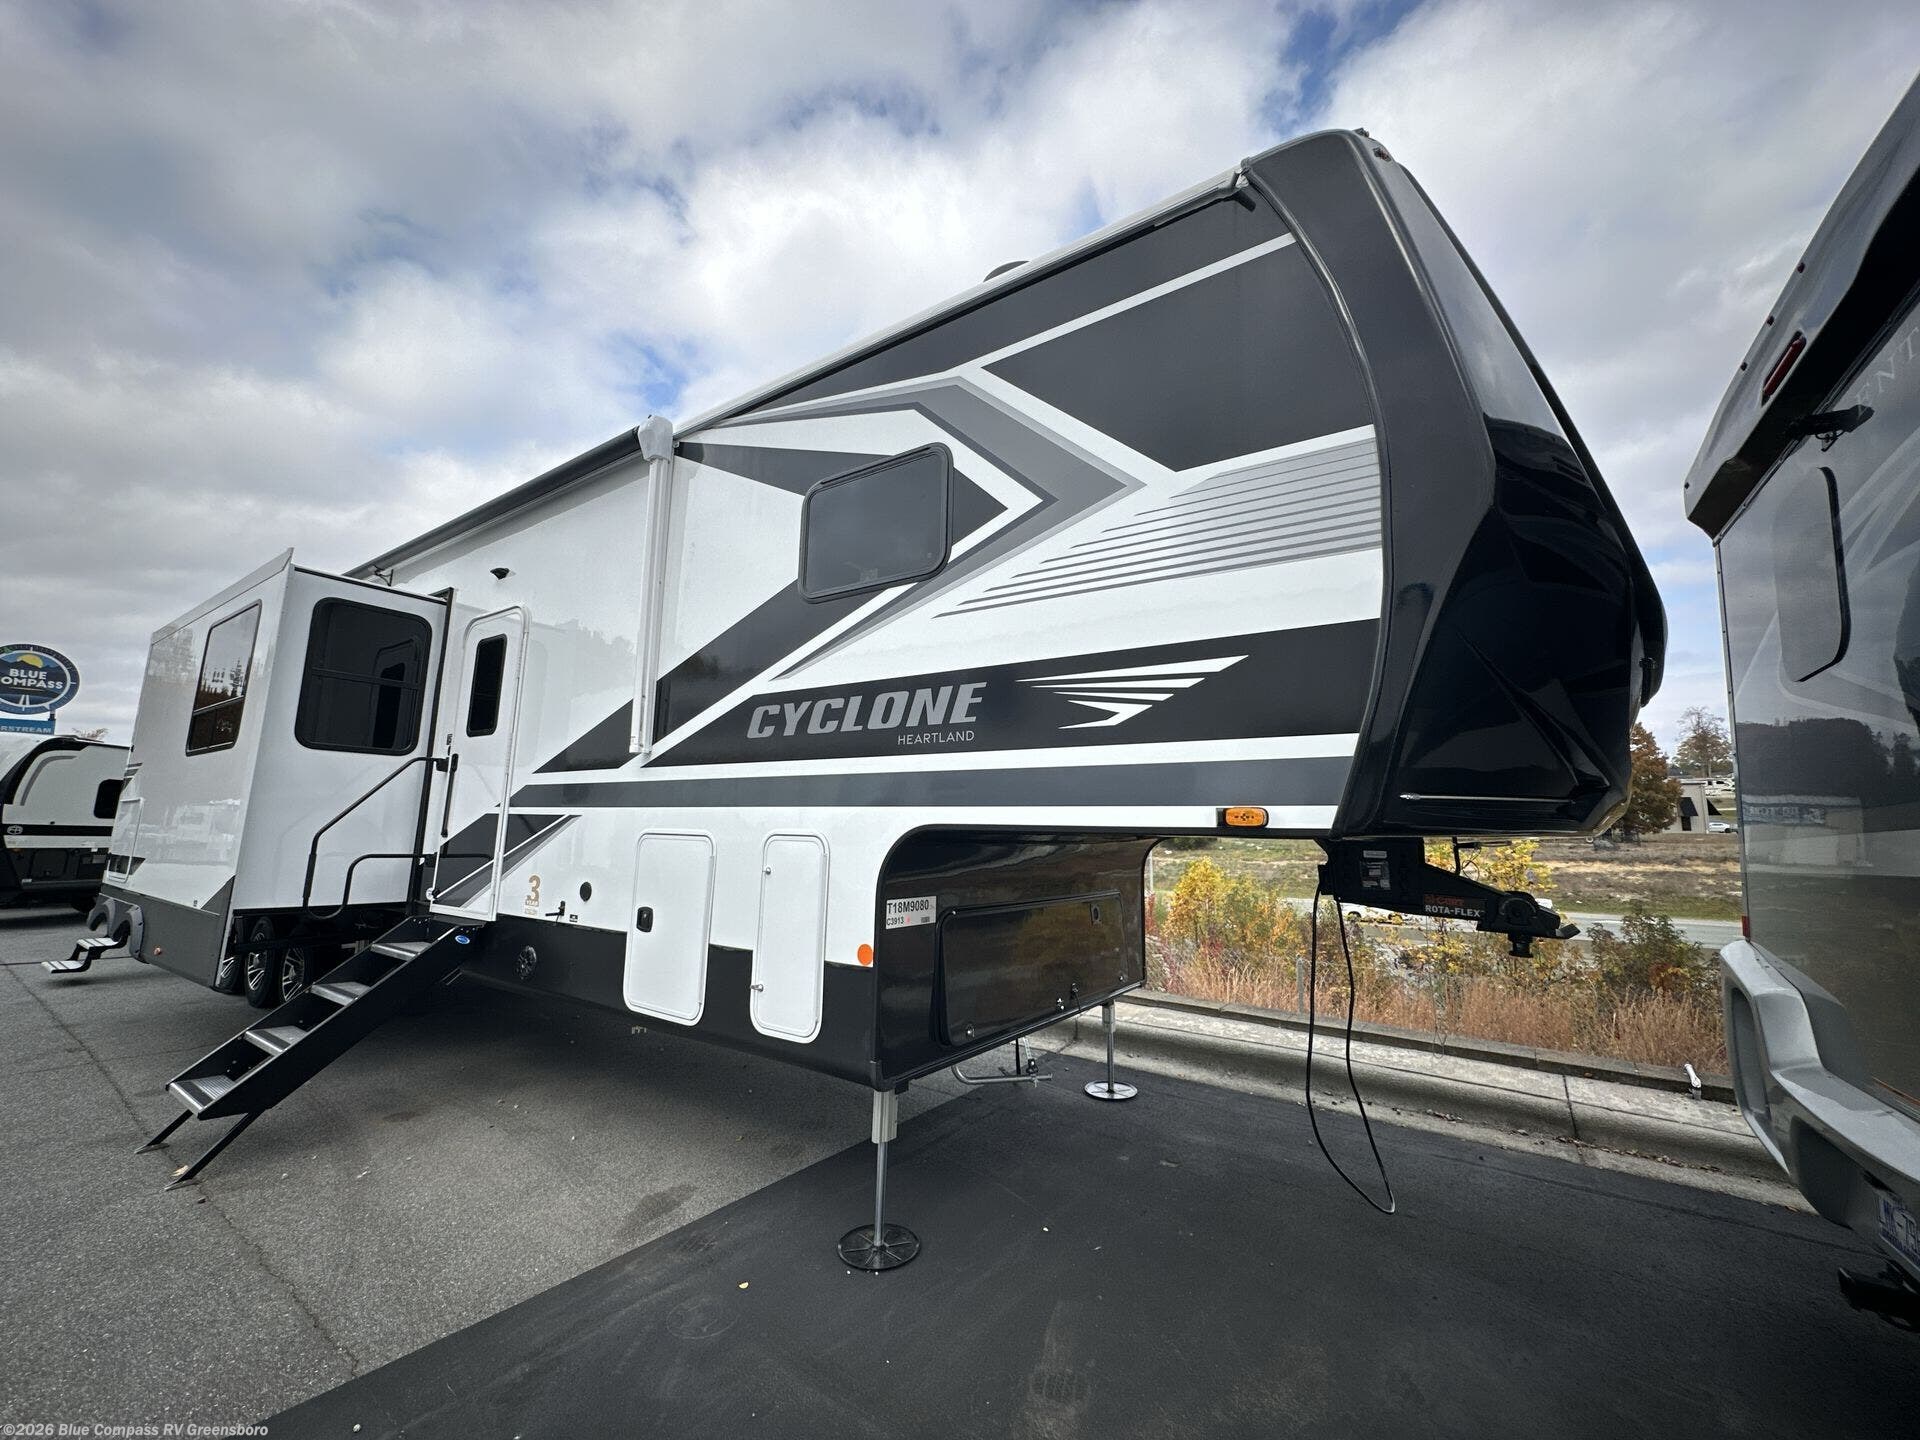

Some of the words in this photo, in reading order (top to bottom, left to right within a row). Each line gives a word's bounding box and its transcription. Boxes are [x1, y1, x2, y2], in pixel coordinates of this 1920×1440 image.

[9, 668, 48, 680] BLUE
[746, 681, 987, 738] CYCLONE
[897, 730, 975, 745] HEARTLAND
[526, 875, 541, 901] 3
[887, 899, 930, 914] T18M9080
[1424, 904, 1481, 918] ROTA-FLEX
